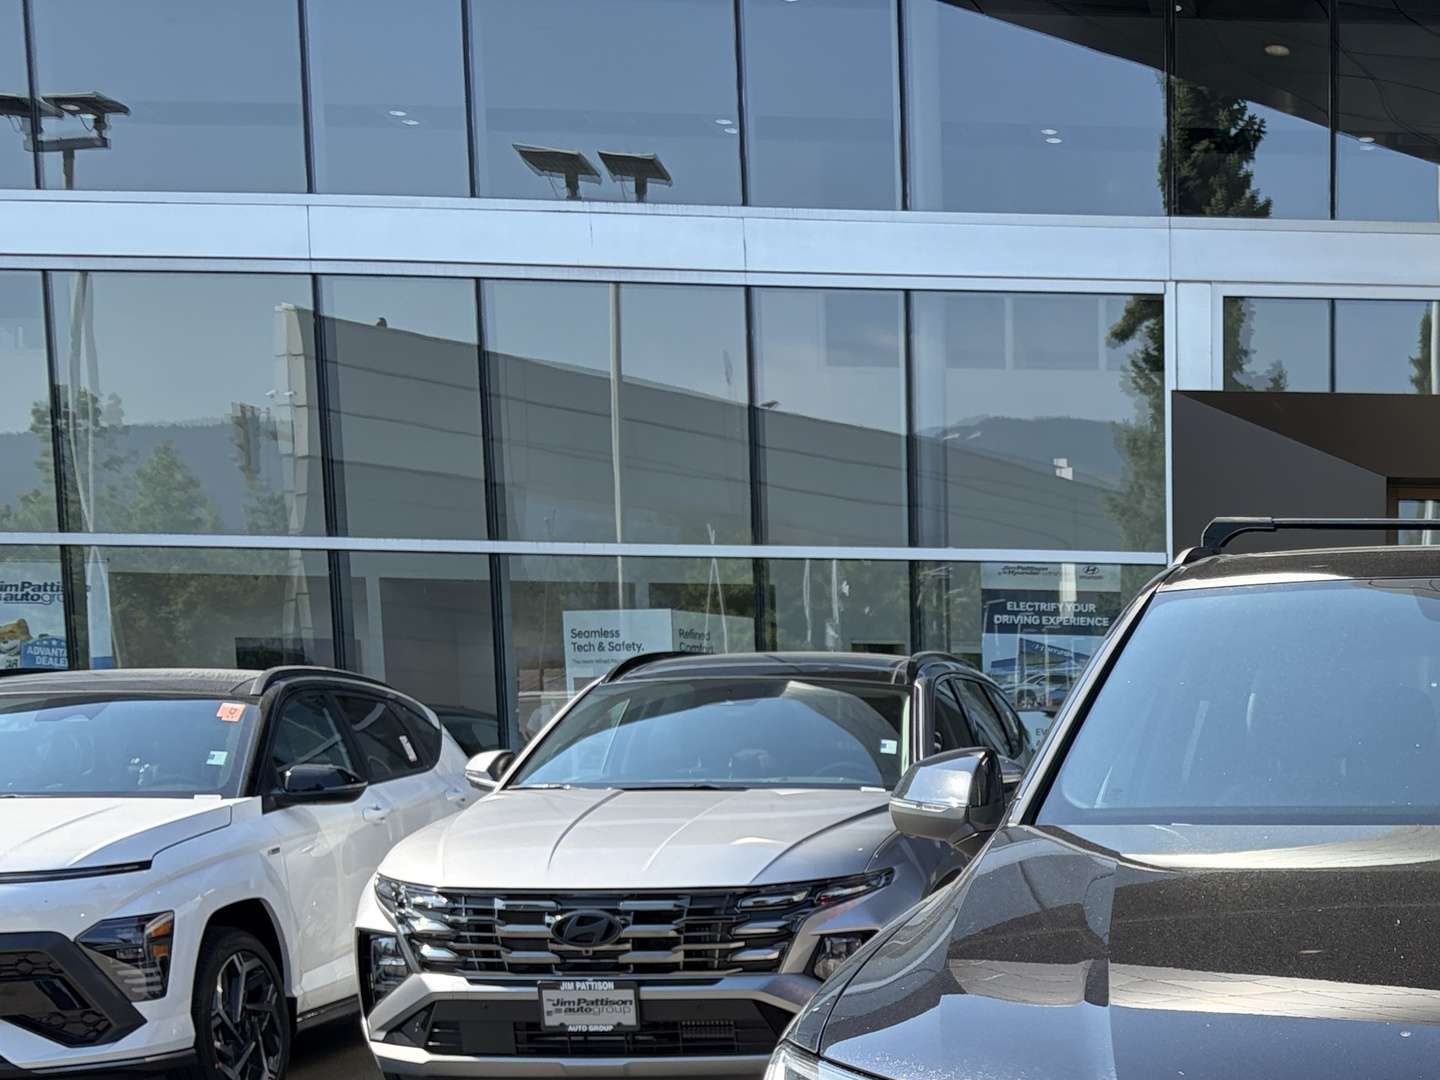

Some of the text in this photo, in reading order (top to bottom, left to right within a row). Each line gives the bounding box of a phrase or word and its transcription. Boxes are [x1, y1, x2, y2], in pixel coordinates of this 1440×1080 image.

[1006, 601, 1096, 613] ELECTRIFY YOUR
[994, 615, 1110, 626] DRIVING EXPERIENCE
[570, 627, 620, 639] Seamless
[571, 641, 645, 653] Tech & Safety.
[560, 981, 614, 991] JIM PATTISON
[552, 998, 633, 1007] Jim Pattison
